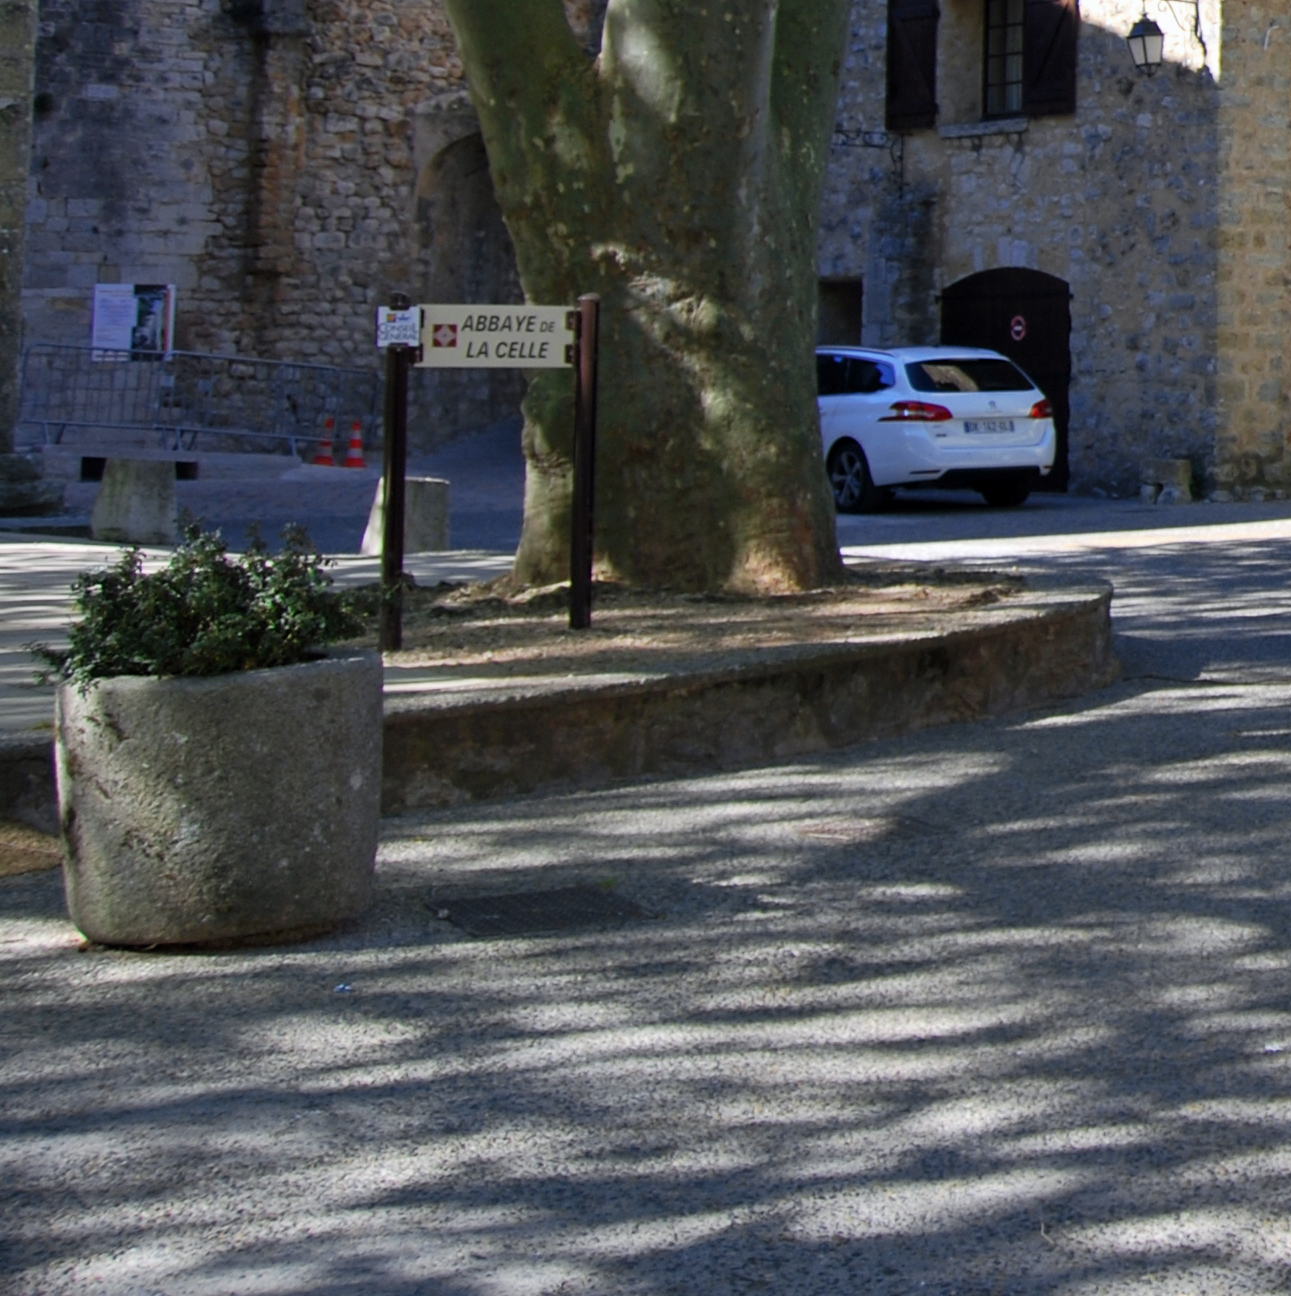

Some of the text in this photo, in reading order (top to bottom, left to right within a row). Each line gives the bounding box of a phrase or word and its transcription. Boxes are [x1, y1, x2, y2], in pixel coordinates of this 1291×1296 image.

[461, 315, 555, 332] ABBAYE DE
[466, 341, 549, 358] LA CELLE
